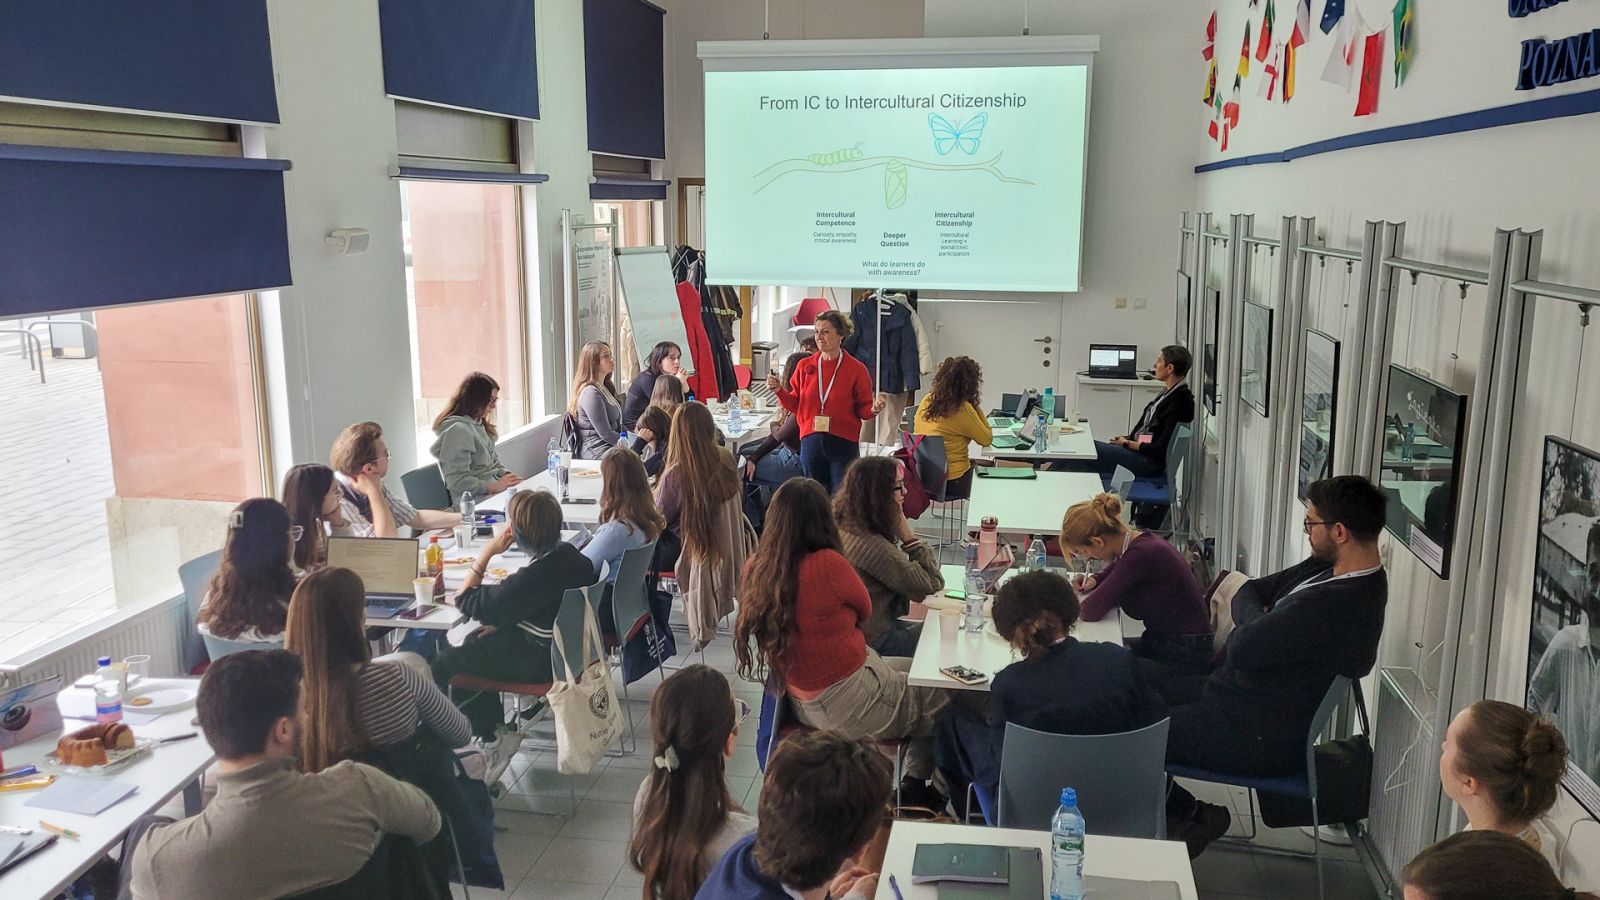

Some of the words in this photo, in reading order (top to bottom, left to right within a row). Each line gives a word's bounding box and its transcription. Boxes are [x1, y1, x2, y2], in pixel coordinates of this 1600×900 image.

[1515, 29, 1600, 90] POZNA
[760, 96, 799, 110] From
[804, 95, 821, 110] IC
[825, 96, 840, 109] to
[845, 94, 934, 109] Intercultural
[940, 92, 1027, 109] Citizenship
[815, 219, 856, 228] Competence
[935, 219, 974, 228] Citizenship
[813, 231, 835, 239] Curiosity,
[883, 231, 908, 240] Deeper
[880, 240, 910, 248] Question
[862, 260, 879, 268] What
[879, 260, 889, 268] do
[889, 260, 916, 268] learners
[916, 260, 926, 268] do
[867, 268, 882, 276] with
[883, 268, 921, 276] awareness?
